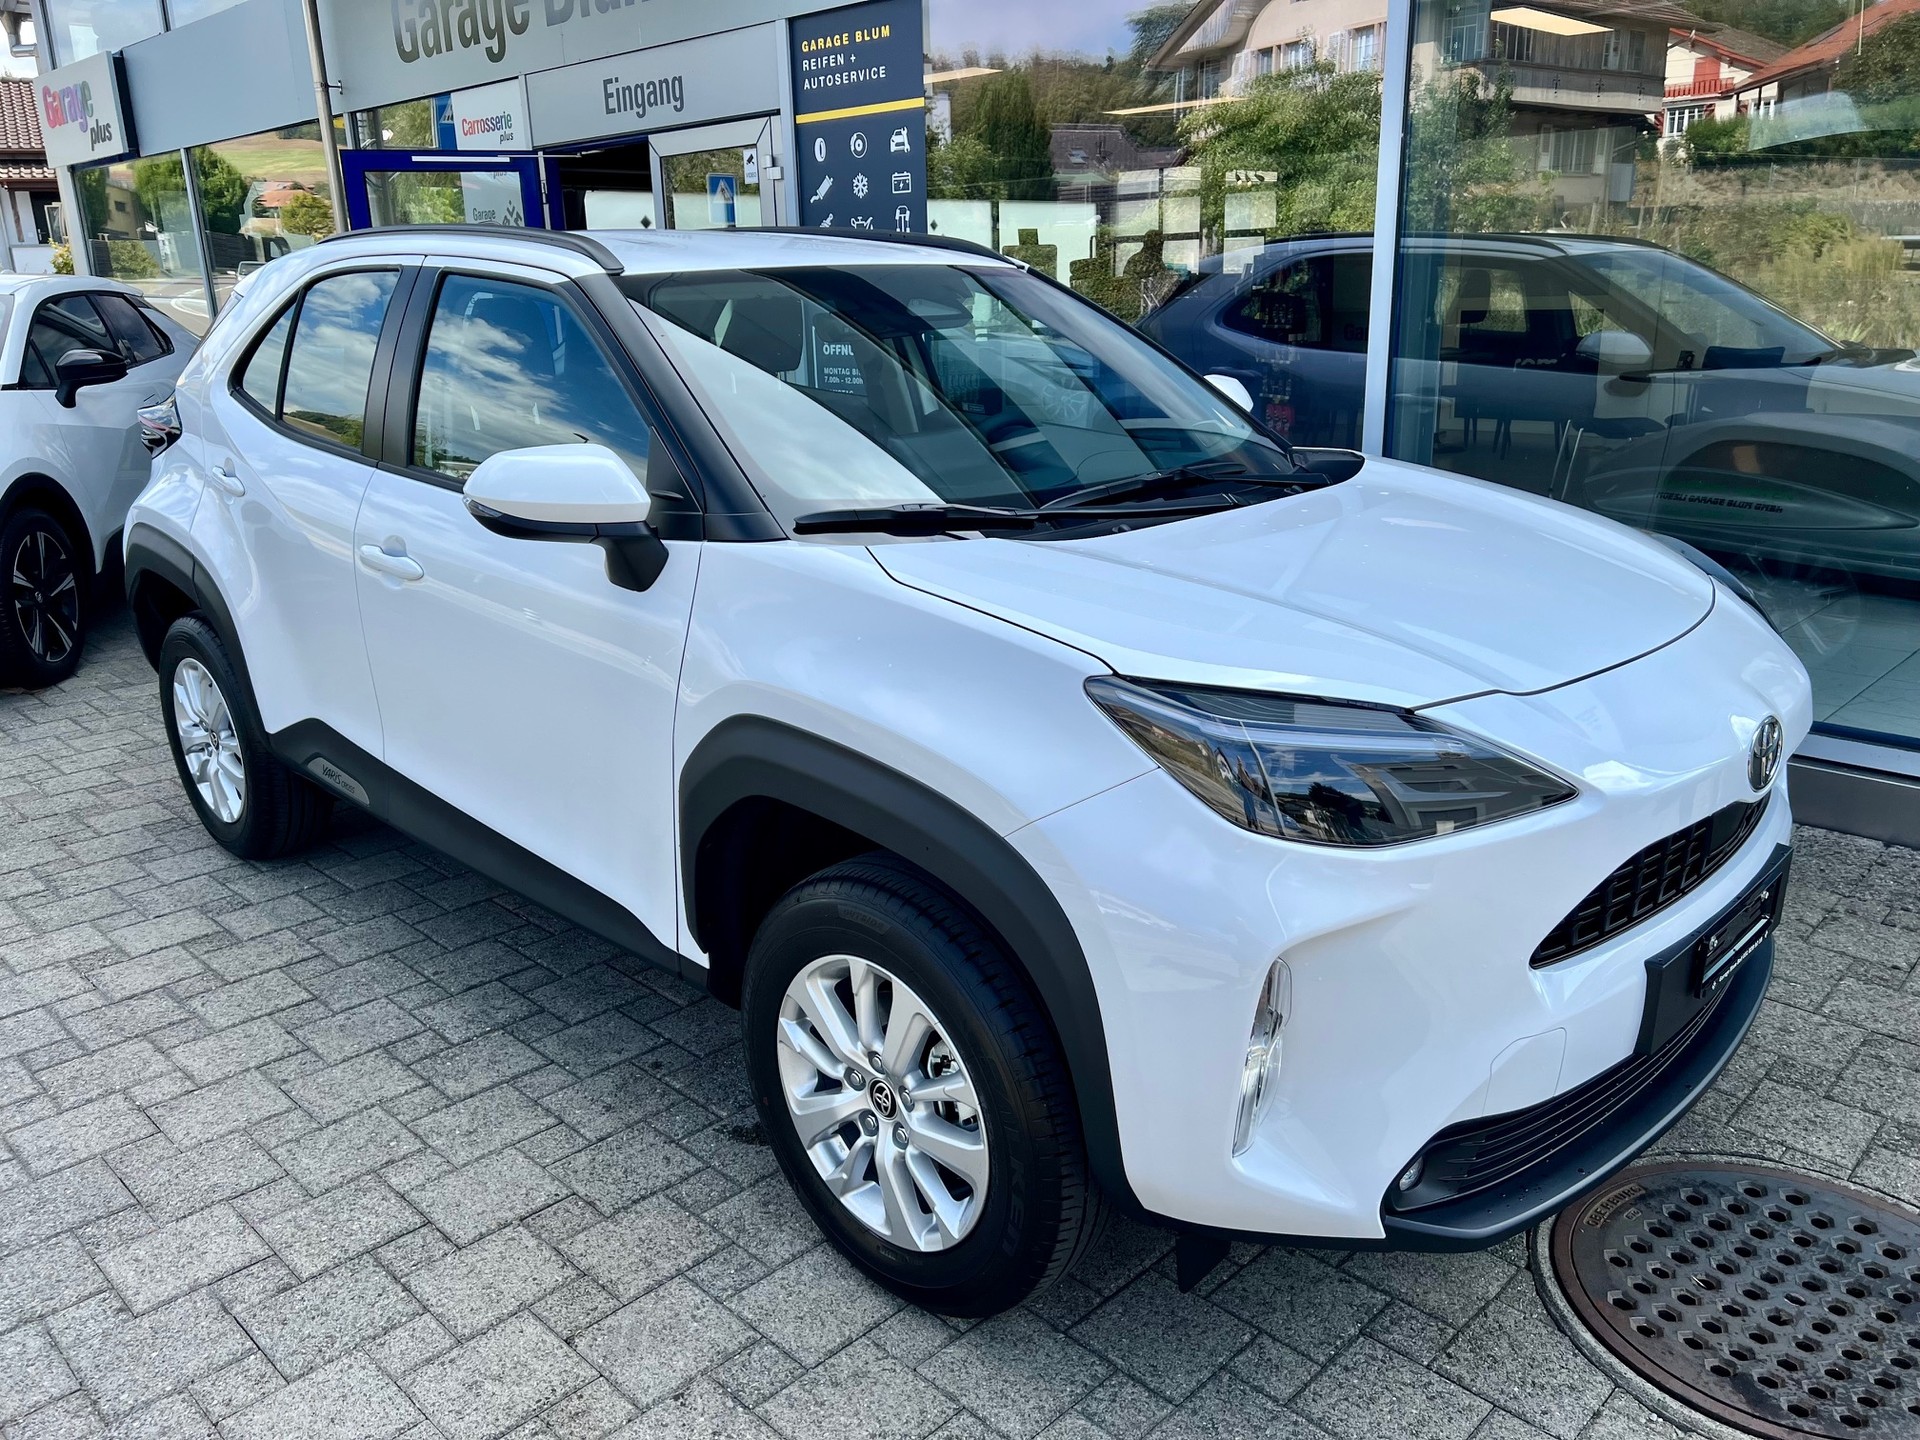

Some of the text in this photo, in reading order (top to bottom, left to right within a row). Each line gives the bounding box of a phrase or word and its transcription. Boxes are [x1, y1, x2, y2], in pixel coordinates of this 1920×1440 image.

[802, 25, 890, 52] GARAGE BLUM
[802, 53, 844, 71] REIFEN
[804, 66, 886, 90] AUTOSERVICE
[42, 80, 94, 133] Garage
[603, 75, 685, 119] Eingang
[90, 118, 112, 151] plus
[461, 111, 512, 137] Carrosserie
[499, 131, 514, 144] plus
[824, 367, 850, 375] MONTAG
[1688, 494, 1726, 506] GARAGE
[1586, 1185, 1642, 1227] OBERBURG
